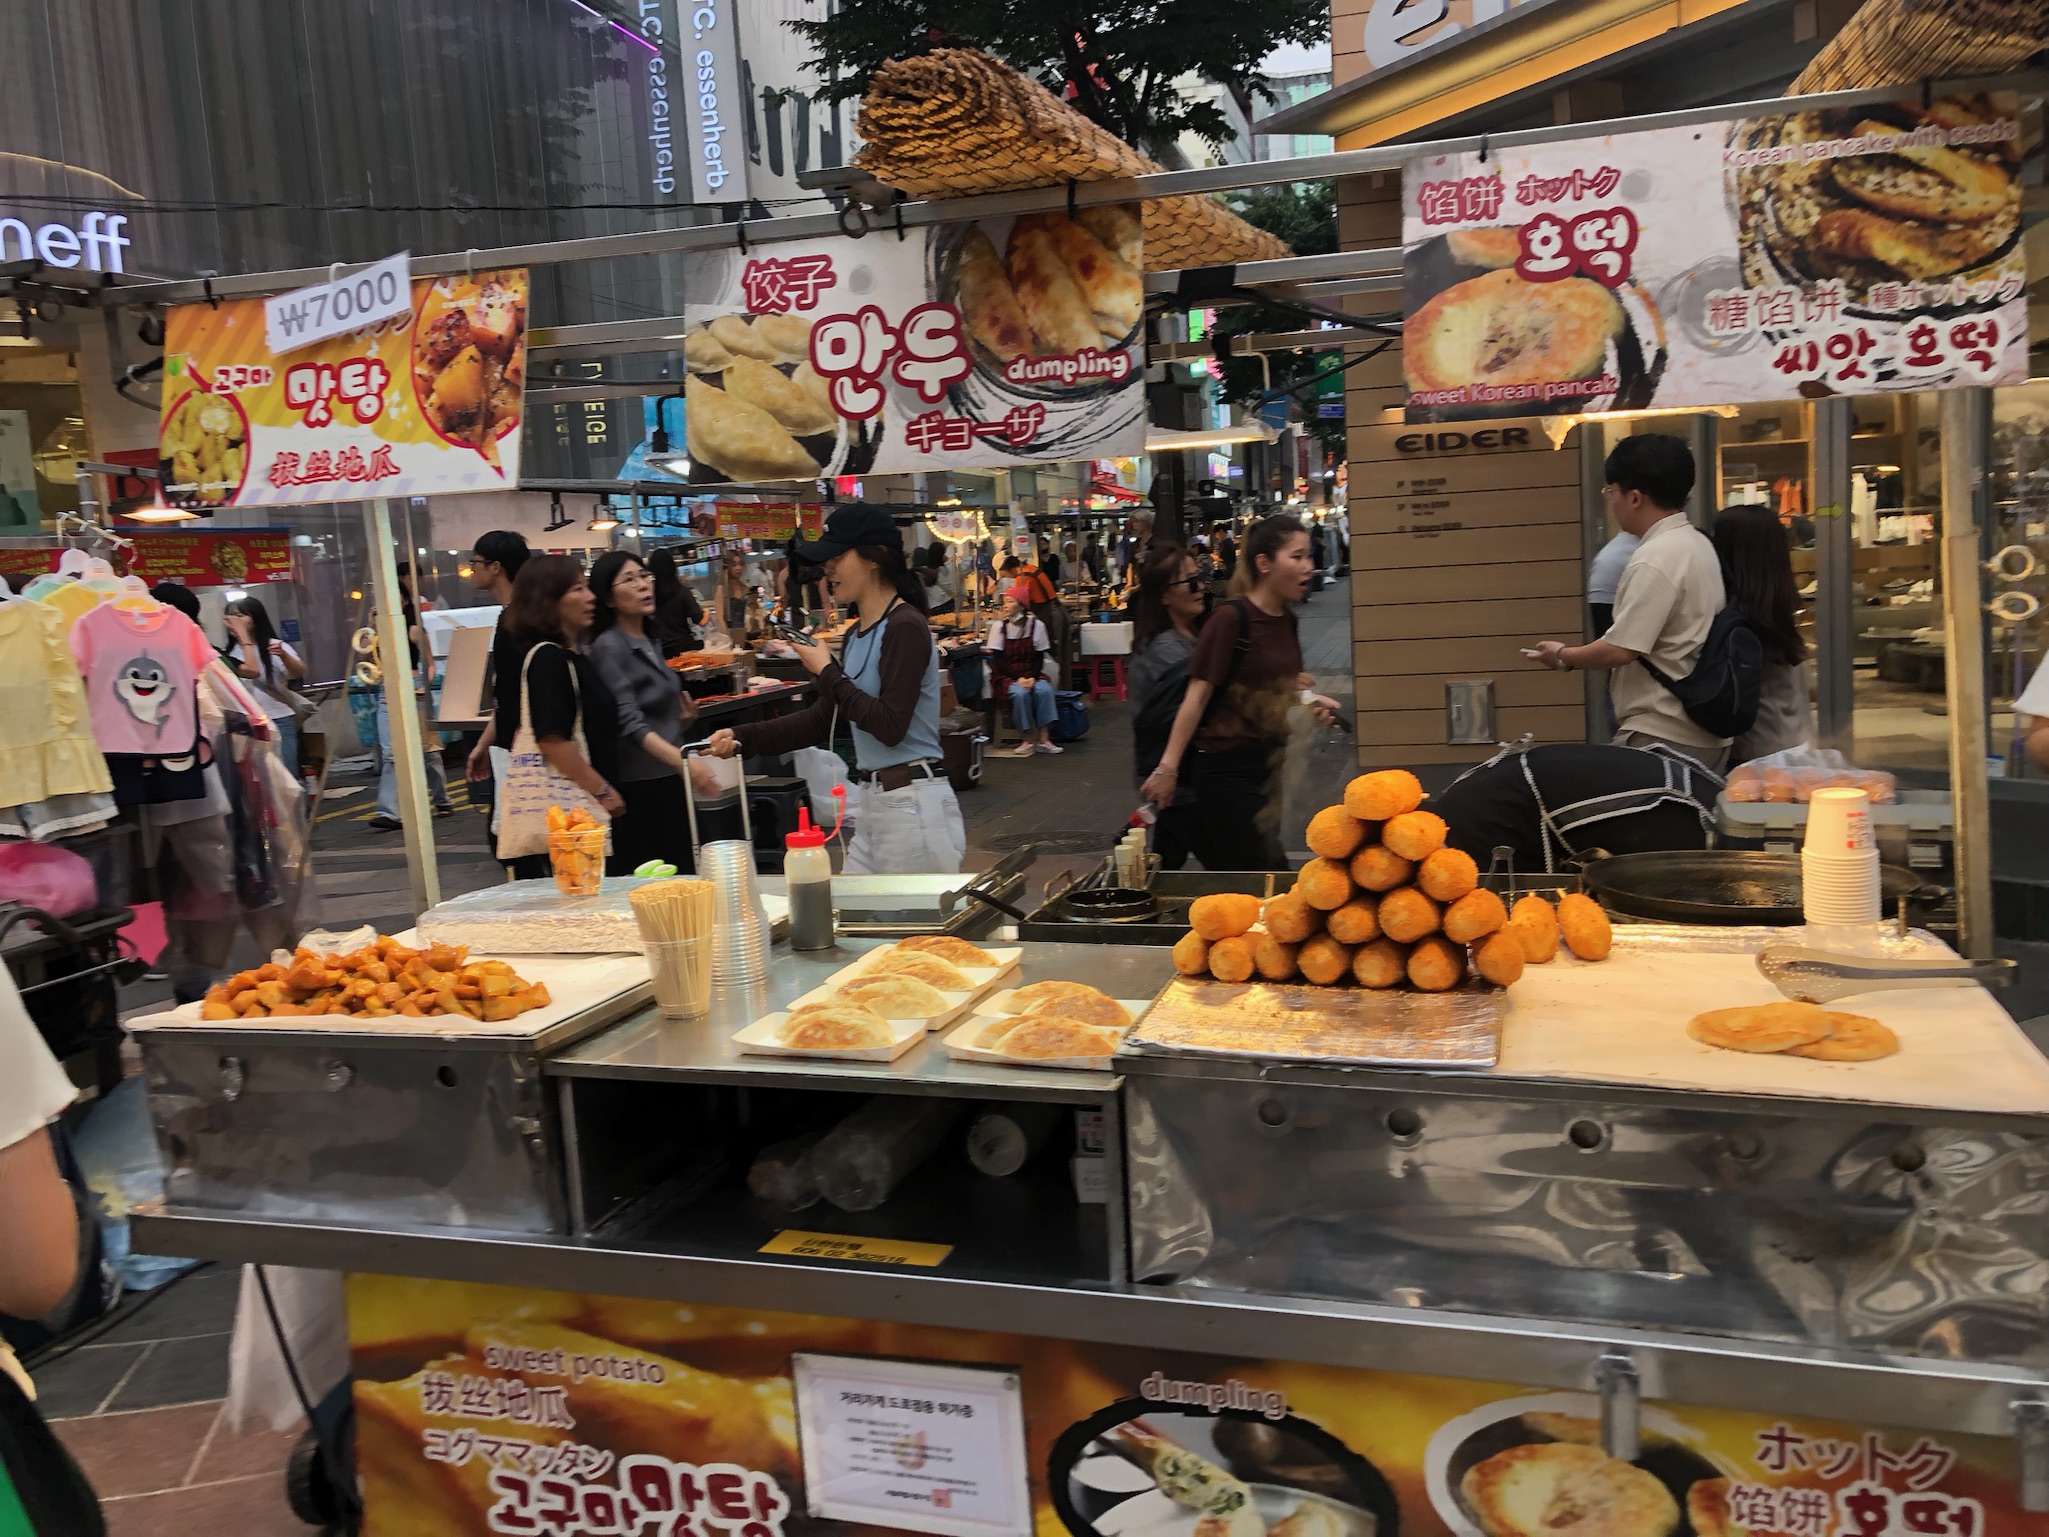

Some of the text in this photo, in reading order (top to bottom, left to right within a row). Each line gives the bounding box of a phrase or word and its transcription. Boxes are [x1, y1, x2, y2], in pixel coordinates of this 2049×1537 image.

[695, 49, 730, 188] essenherb
[1722, 147, 1797, 167] Korean
[1803, 136, 1893, 163] pancake
[1900, 123, 1945, 147] with
[1420, 177, 1502, 222] 馅饼
[1516, 168, 1621, 203] ホットク
[1521, 211, 1633, 284] 호떡
[744, 258, 834, 310] 饺子
[1707, 280, 1843, 330] 糖馅饼
[813, 305, 969, 417] 만두
[1007, 350, 1130, 383] dumpling
[1772, 318, 2000, 382] 씨앗 호떡
[213, 360, 389, 426] 고구마 맛탕
[1471, 382, 1538, 402] Korean
[908, 405, 1043, 451] ギョーザ
[1394, 426, 1530, 452] EIDER
[484, 1345, 665, 1384] sweet potato
[1140, 1371, 1286, 1420] dumpling
[1757, 1426, 1951, 1487] ホットク
[492, 1472, 641, 1533] 고구마
[1731, 1486, 1827, 1535] 馅饼
